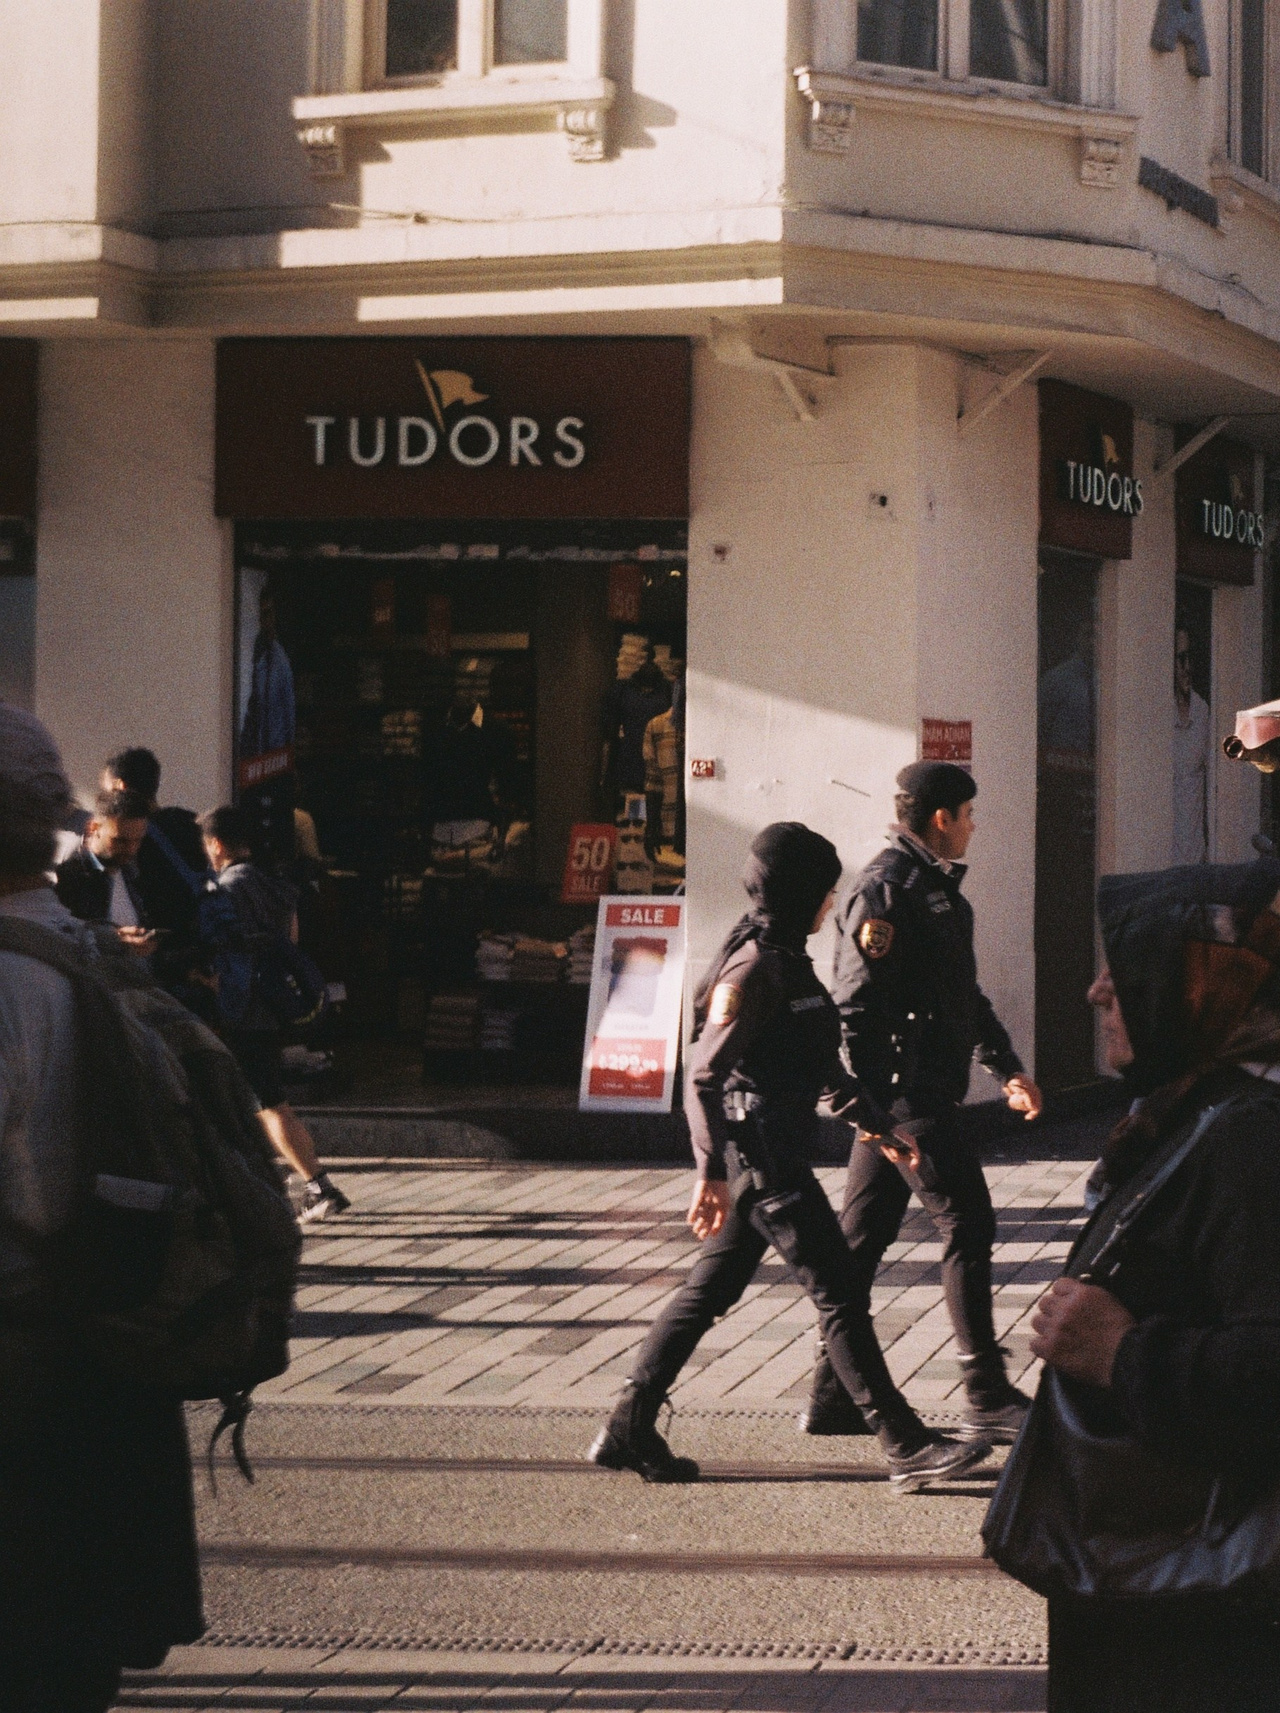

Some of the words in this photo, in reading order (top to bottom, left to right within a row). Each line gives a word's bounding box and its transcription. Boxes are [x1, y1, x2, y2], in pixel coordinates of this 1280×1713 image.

[305, 415, 587, 469] TUDORS
[1066, 460, 1144, 516] TUDORS
[1202, 499, 1264, 548] TUDORS
[571, 836, 610, 871] 50
[571, 875, 601, 892] SALE
[619, 907, 665, 925] SALE
